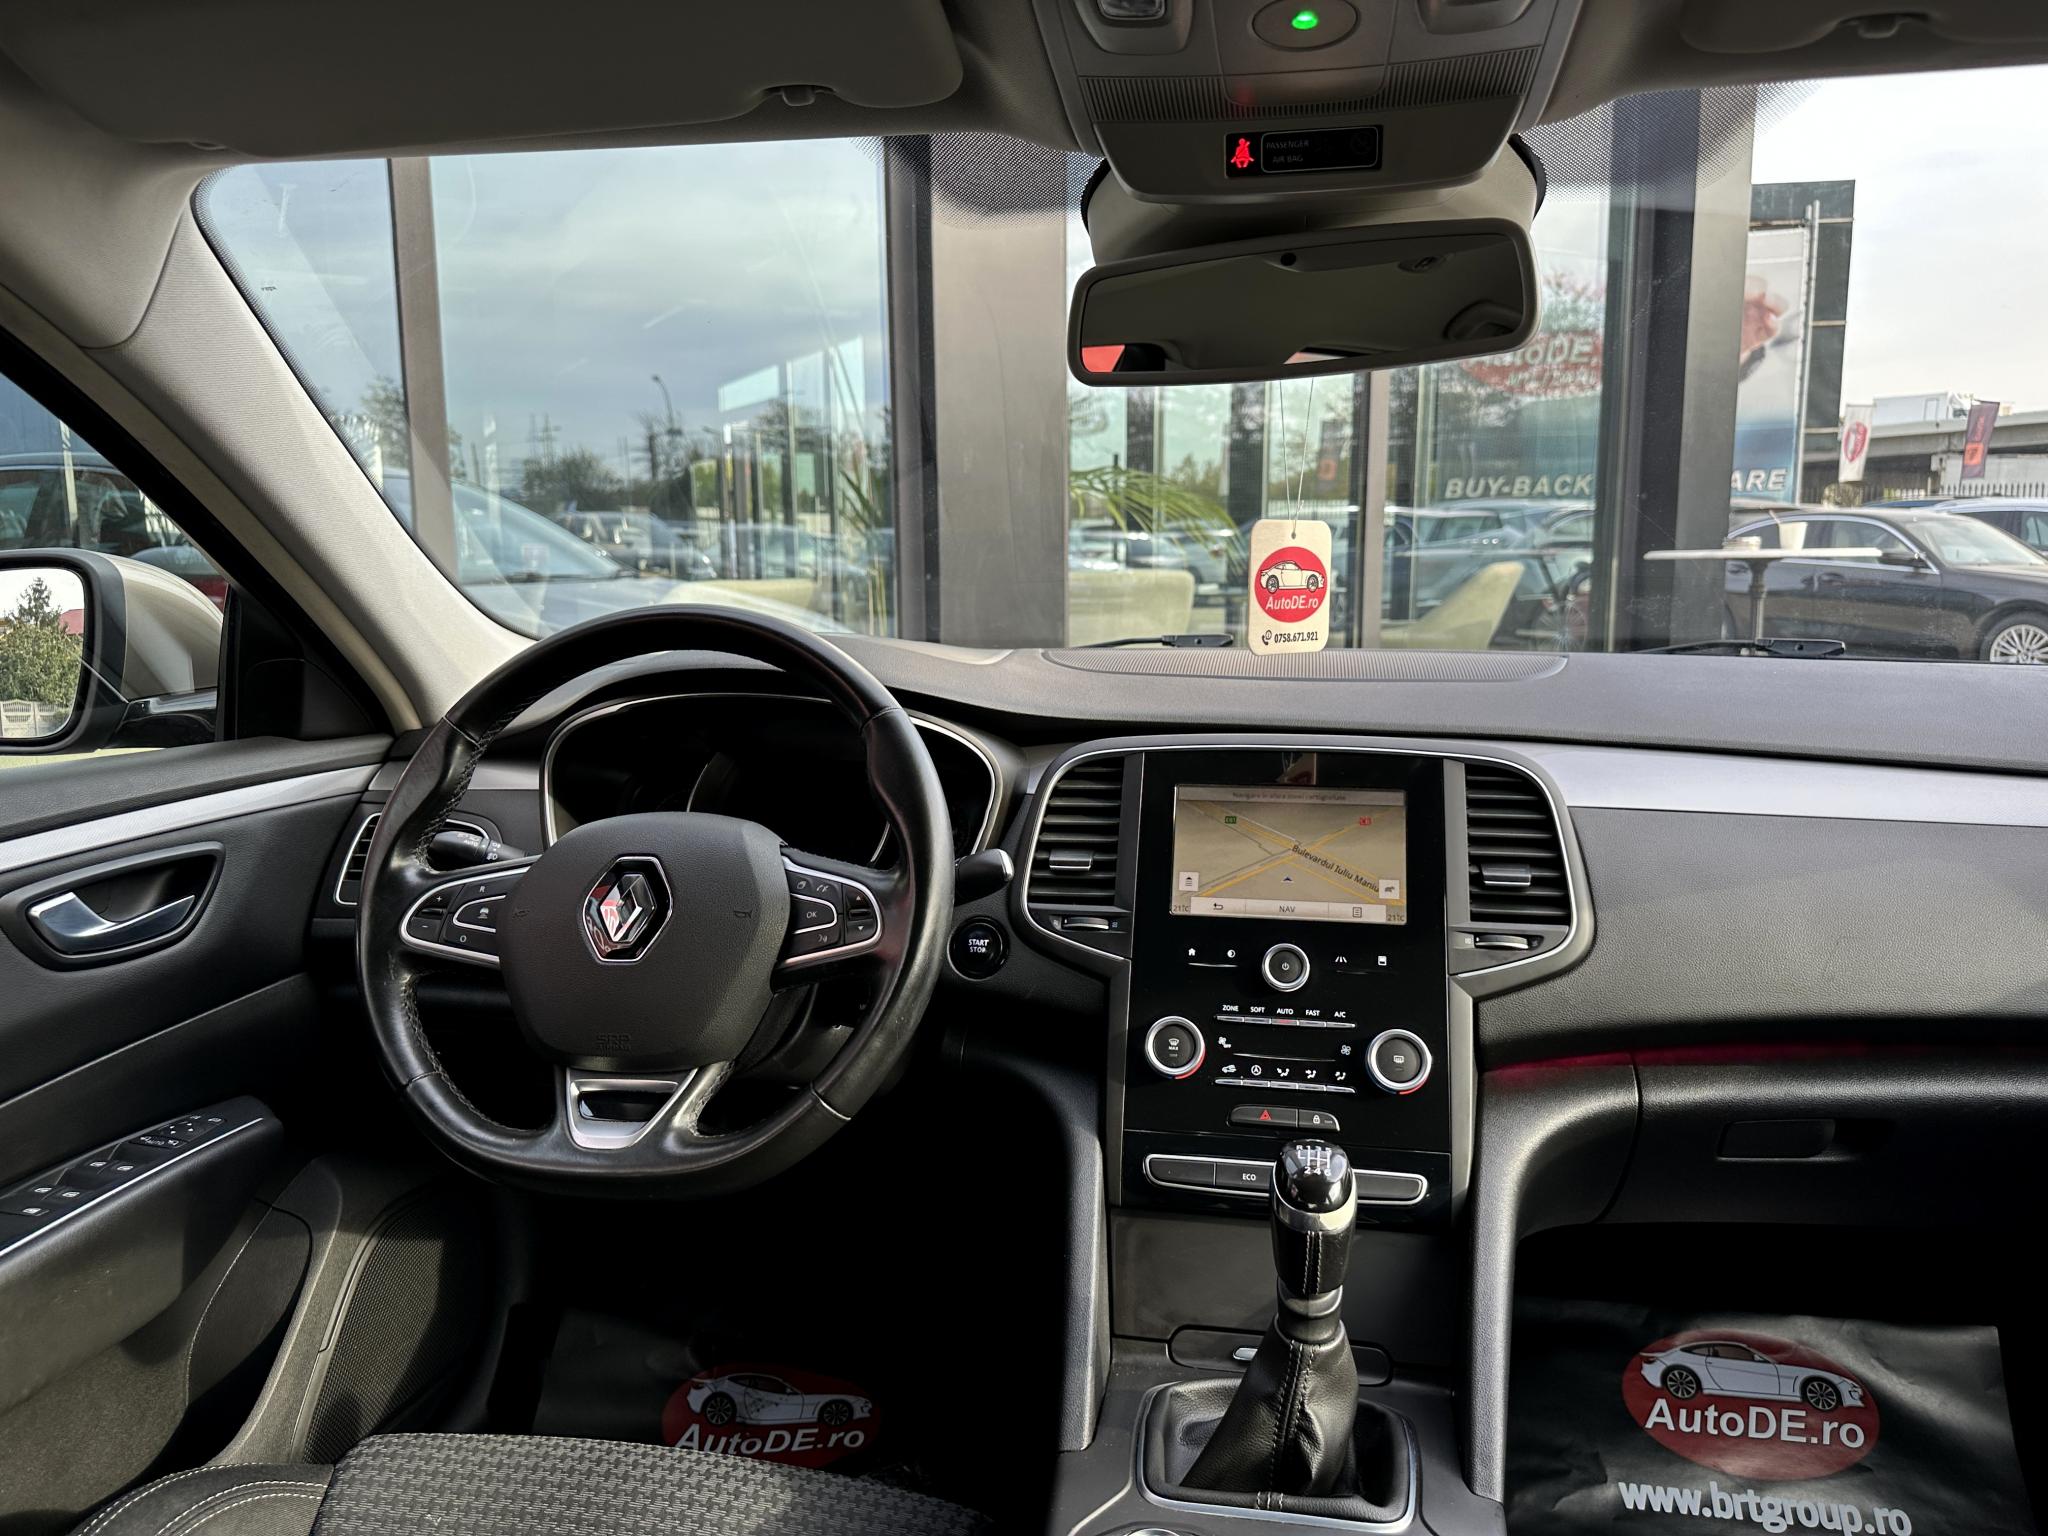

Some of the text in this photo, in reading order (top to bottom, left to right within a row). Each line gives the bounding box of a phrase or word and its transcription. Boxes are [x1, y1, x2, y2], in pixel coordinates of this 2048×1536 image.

[1266, 140, 1309, 149] PASSENGER
[1444, 474, 1594, 499] BUY-BACK
[1265, 595, 1319, 610] AutoDE.ro
[1274, 631, 1319, 644] 0758.671.921
[1291, 844, 1380, 894] Bulevardul Iuliu Maniu
[1278, 905, 1296, 913] NAV
[806, 911, 818, 919] OK
[968, 938, 990, 947] START
[1222, 1004, 1239, 1012] ZONE
[1250, 1006, 1265, 1014] SOFT
[1305, 1009, 1320, 1017] FAST
[1242, 1173, 1256, 1182] ECO
[1644, 1397, 1865, 1449] AutoDE.ro
[674, 1422, 866, 1456] AutoDE.ro
[1617, 1480, 1912, 1536] www.brtgroup.ro
